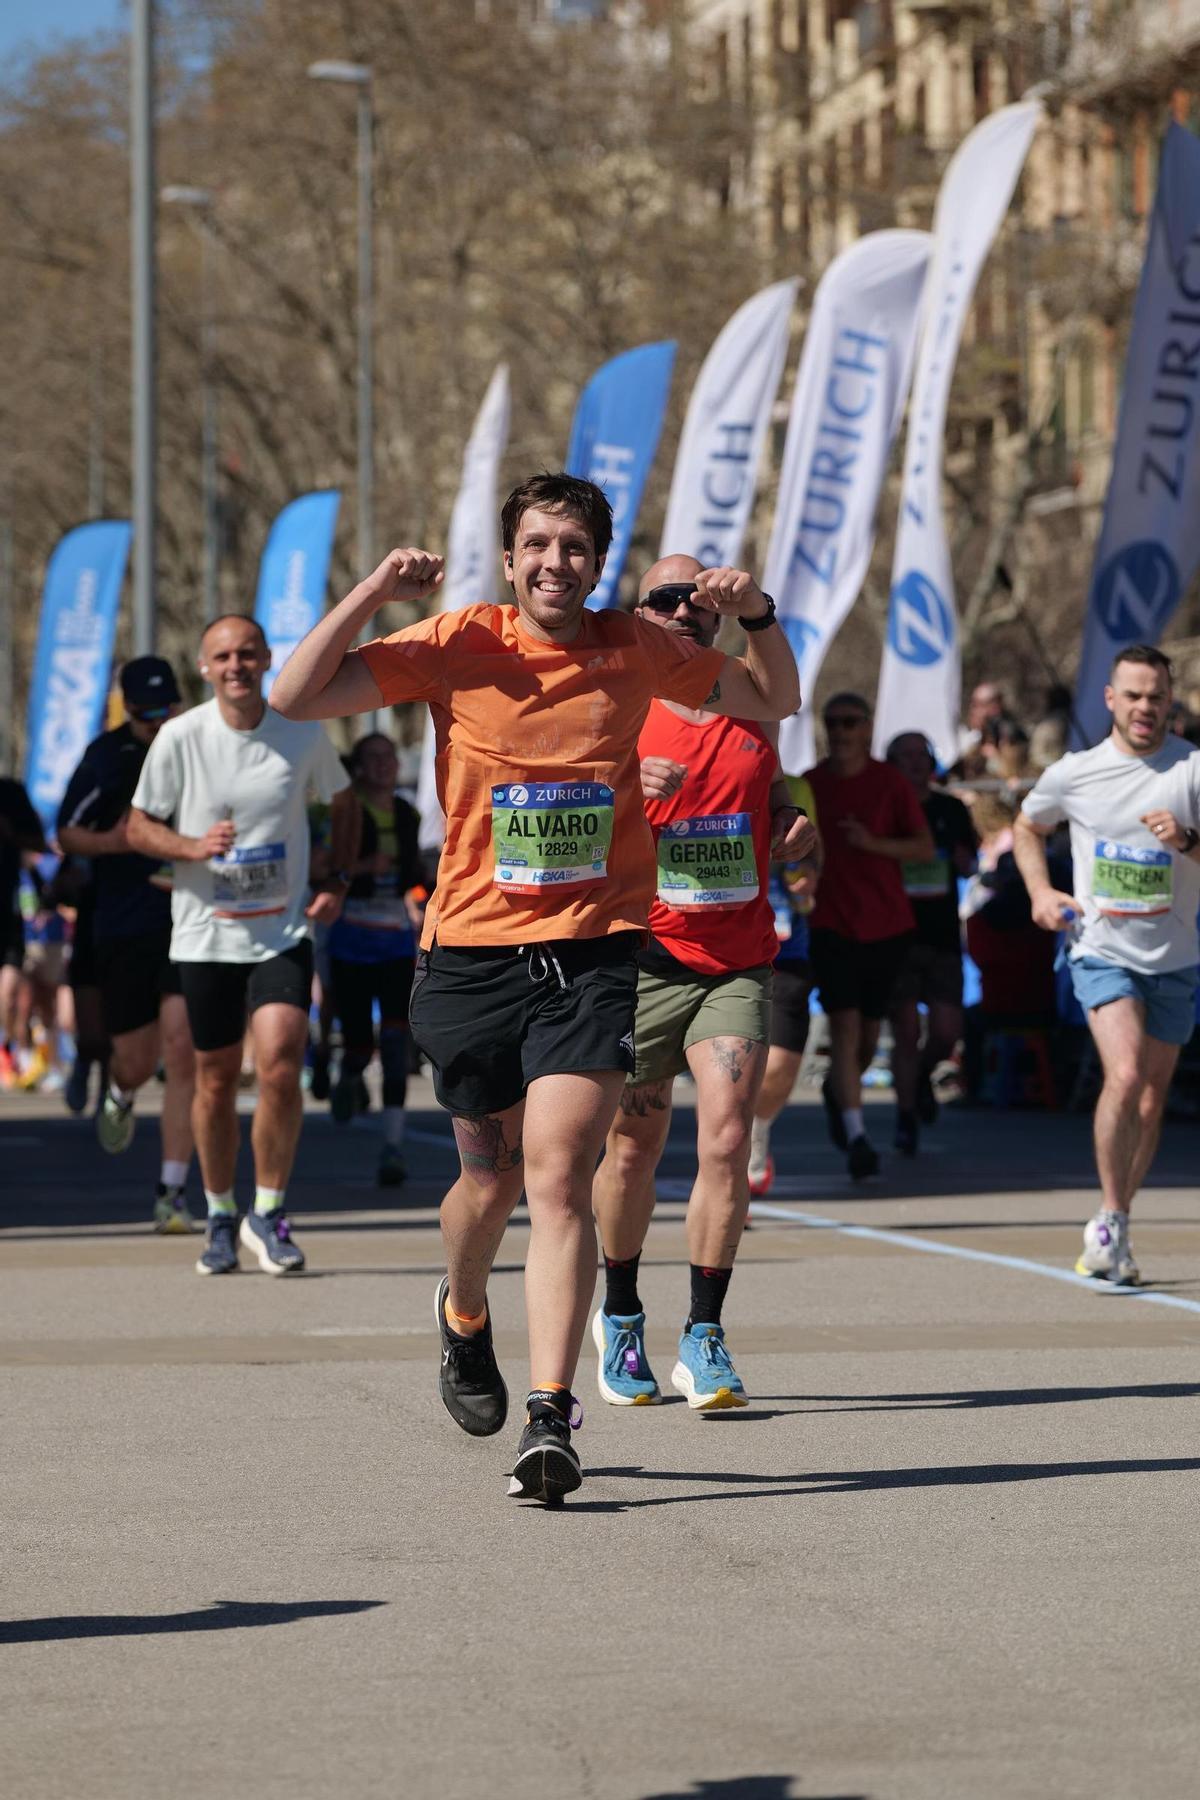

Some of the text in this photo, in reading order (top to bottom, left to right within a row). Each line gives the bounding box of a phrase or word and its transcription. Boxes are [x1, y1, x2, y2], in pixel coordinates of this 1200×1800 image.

[1137, 232, 1200, 502] ZURIC
[788, 326, 889, 586] ZURICH
[696, 422, 753, 569] RICH
[535, 787, 591, 802] ZURICH
[507, 809, 598, 838] ÁLVARO
[695, 819, 737, 831] ZURICH
[536, 841, 578, 857] 12829
[670, 841, 745, 863] GERARD
[532, 870, 566, 882] HOKA
[695, 865, 730, 879] 29443
[1097, 861, 1164, 883] STEPHEN
[693, 891, 722, 902] HOKA
